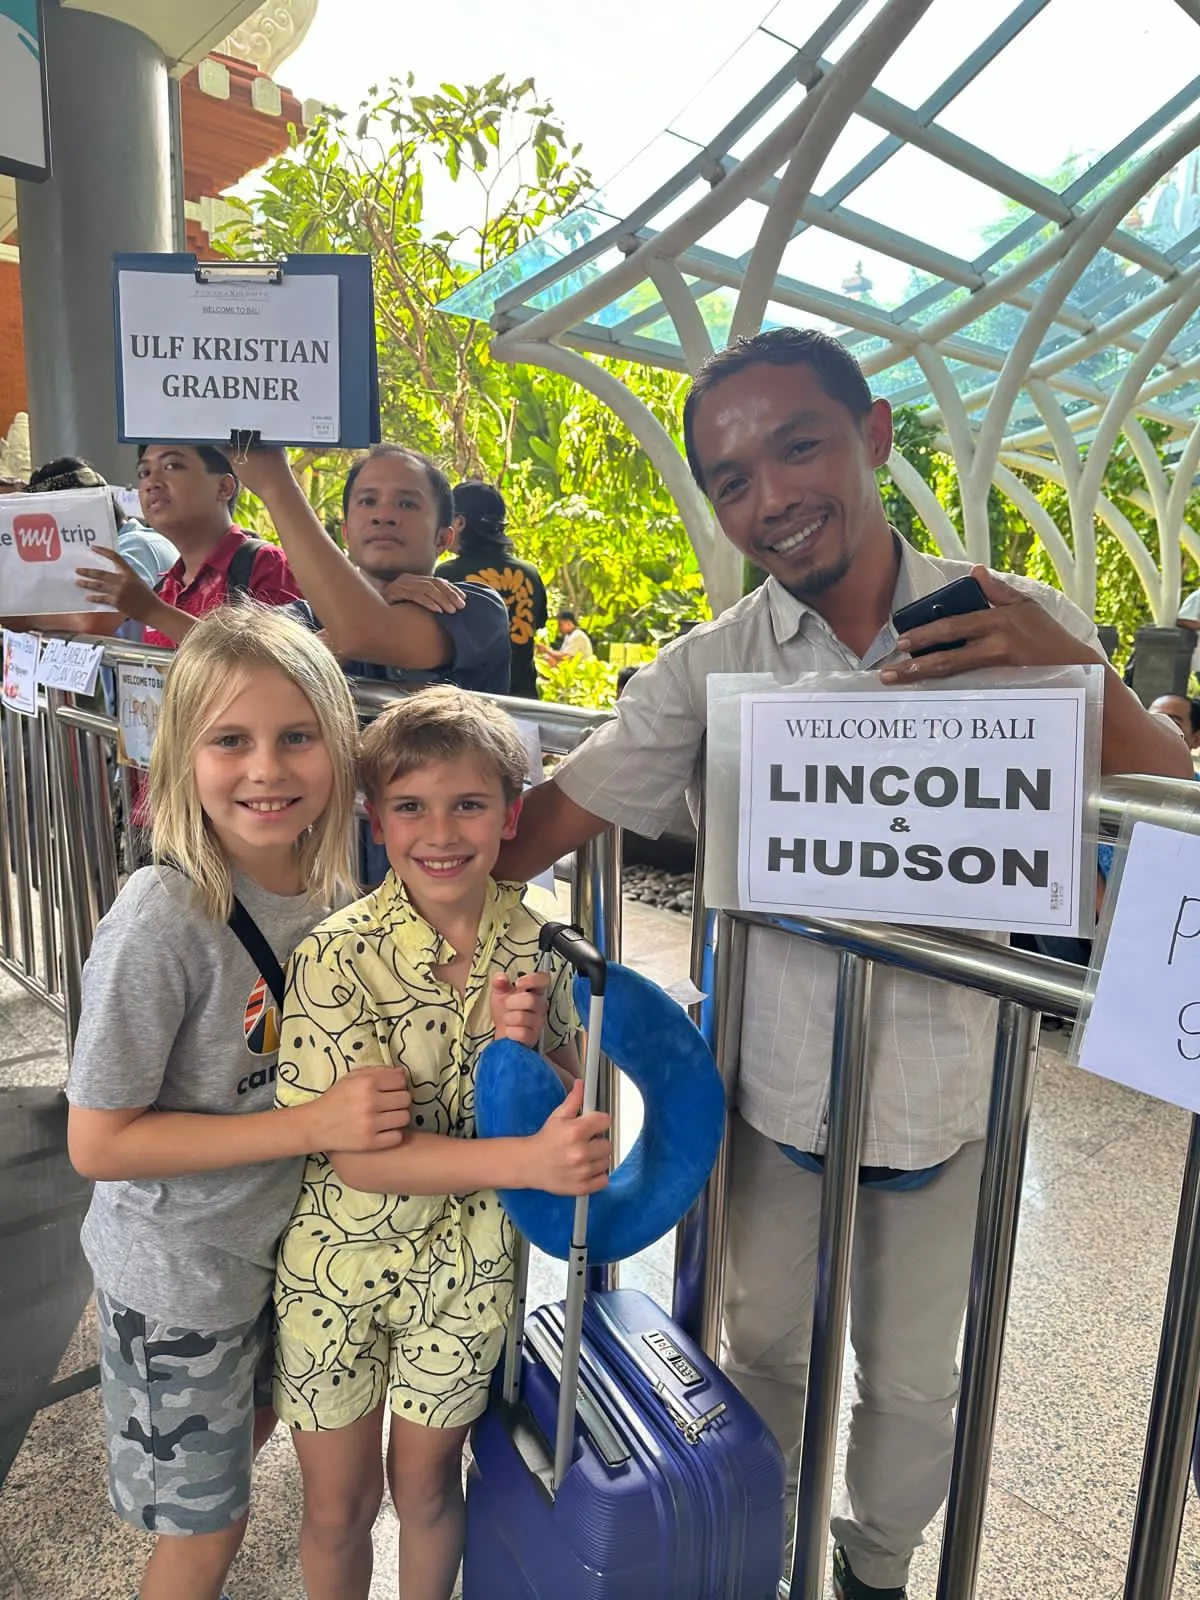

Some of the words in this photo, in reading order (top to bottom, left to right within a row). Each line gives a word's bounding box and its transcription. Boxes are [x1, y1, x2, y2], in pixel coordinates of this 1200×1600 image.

[130, 334, 184, 359] ULF
[192, 336, 329, 364] KRISTIAN
[162, 374, 300, 401] GRABNER
[0, 532, 12, 546] e
[18, 526, 55, 558] my
[61, 524, 96, 547] trip
[122, 674, 148, 687] WELCOME
[148, 677, 156, 688] TO
[786, 718, 916, 739] WELCOME
[923, 718, 963, 739] TO
[972, 718, 1036, 740] BALI
[769, 764, 1051, 811] LINCOLN
[889, 816, 911, 833] &
[767, 837, 1049, 888] HUDSON
